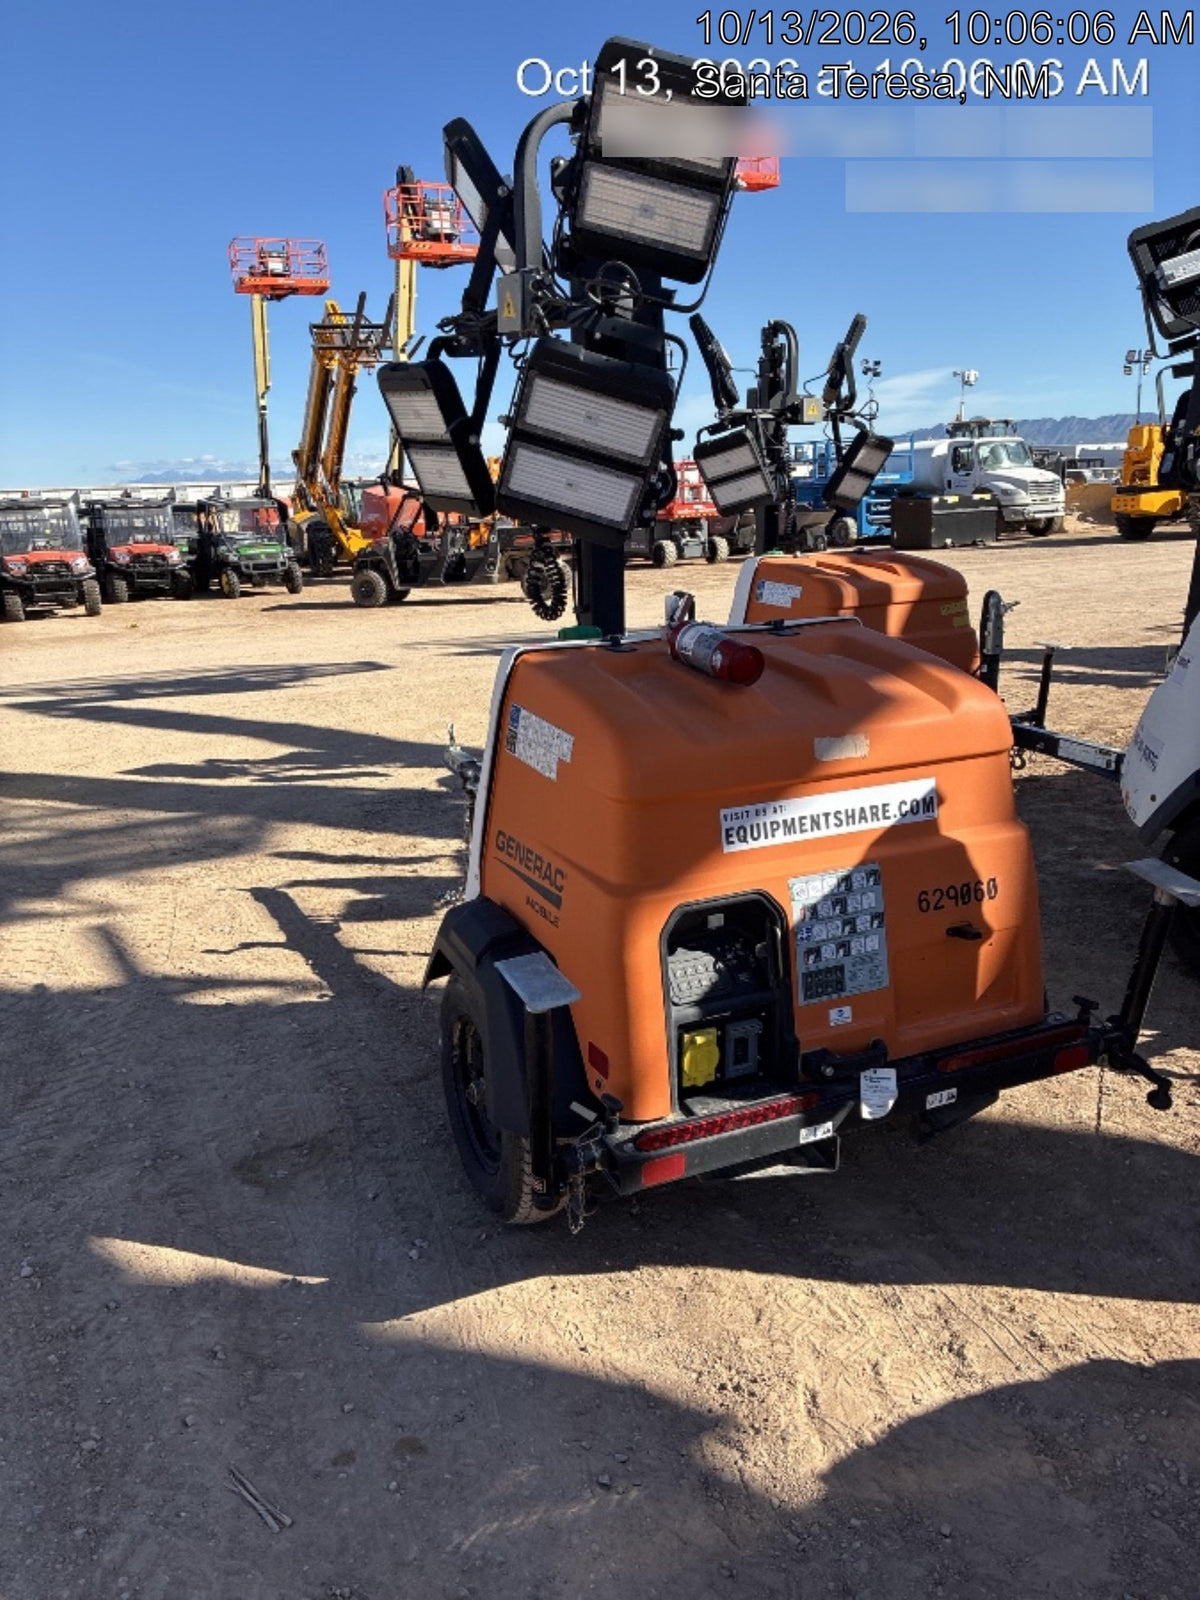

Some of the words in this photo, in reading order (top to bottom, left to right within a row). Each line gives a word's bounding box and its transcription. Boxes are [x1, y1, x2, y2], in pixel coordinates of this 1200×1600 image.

[722, 810, 751, 822] VISIT
[755, 806, 767, 817] US
[724, 796, 935, 846] EQUIPMENTSHARE.COM
[495, 829, 565, 894] GENERAC
[917, 877, 998, 913] 629060
